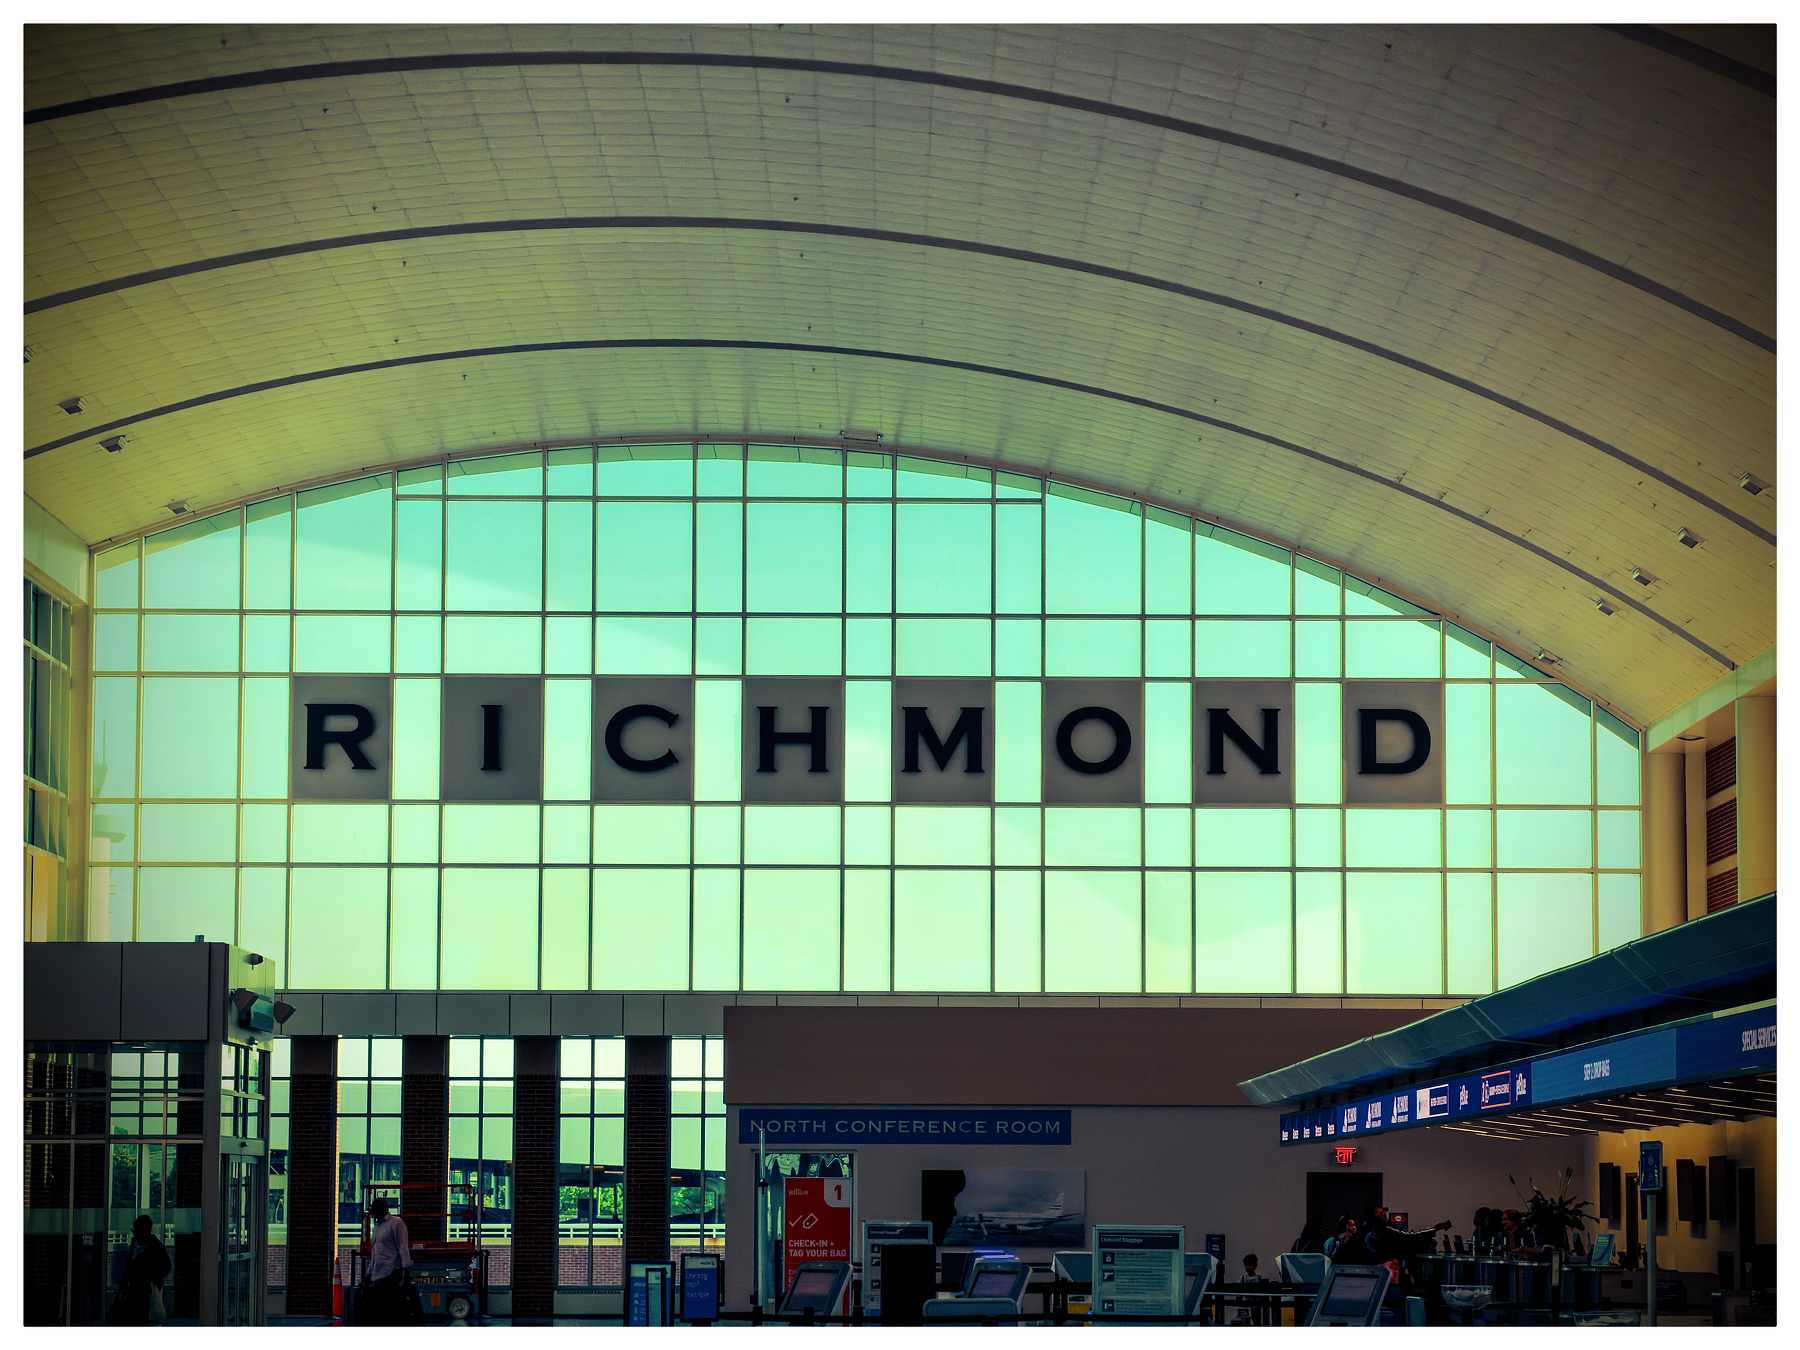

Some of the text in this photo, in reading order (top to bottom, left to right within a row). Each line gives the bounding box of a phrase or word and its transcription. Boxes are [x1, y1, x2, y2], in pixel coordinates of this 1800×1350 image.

[303, 703, 1432, 775] RICHMOND
[1742, 1025, 1777, 1052] SPECIAL SERVICES
[750, 1120, 1060, 1134] NORTH CONFERENCE ROOM
[1337, 1149, 1354, 1163] EXIT
[834, 1184, 842, 1201] 1
[788, 1239, 829, 1248] CHECK-IN
[788, 1249, 847, 1257] TAG YOUR BAG
